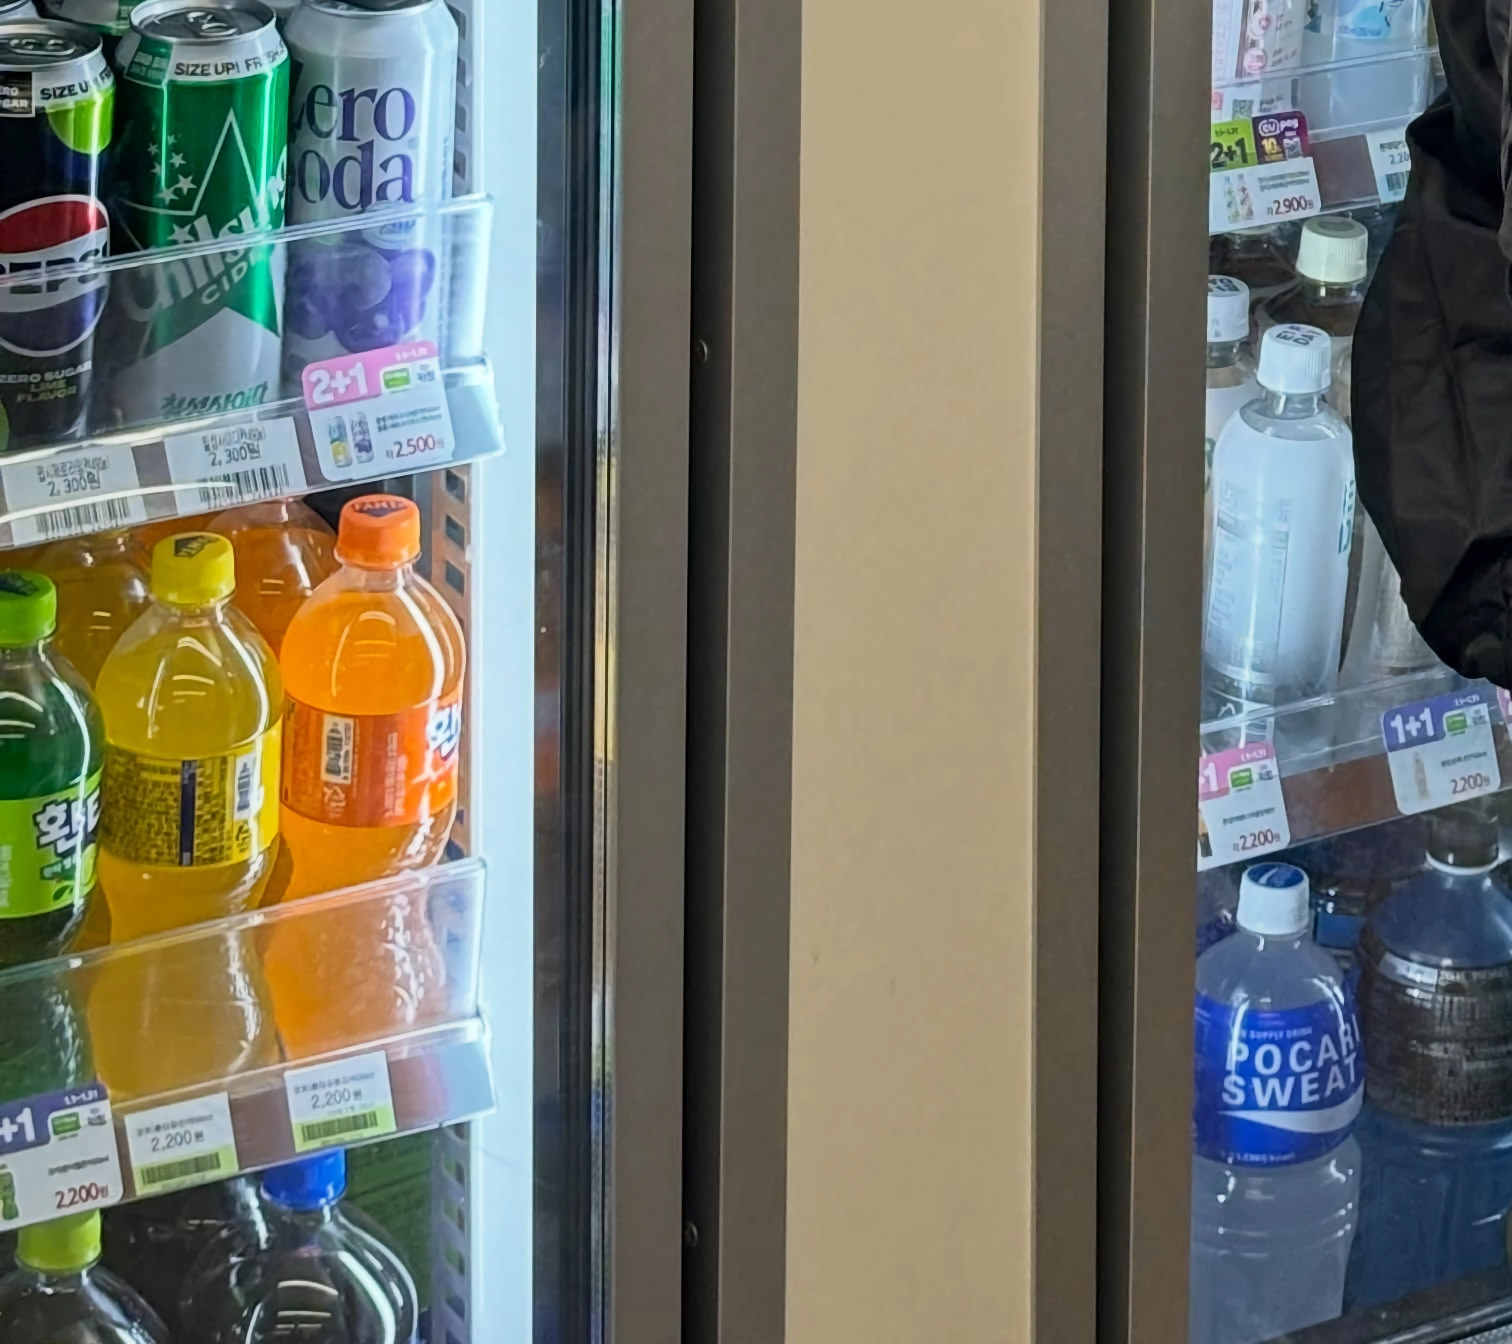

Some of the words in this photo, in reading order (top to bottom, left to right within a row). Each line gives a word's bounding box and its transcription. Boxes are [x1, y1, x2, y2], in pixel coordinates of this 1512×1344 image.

[174, 62, 212, 77] SIZE
[213, 60, 241, 76] UP!
[40, 83, 79, 101] SIZE
[300, 83, 416, 142] ero
[1211, 137, 1249, 169] 2+1
[299, 137, 416, 211] oda
[309, 360, 370, 403] 2+1
[1390, 707, 1435, 744] 1+1
[1225, 1014, 1361, 1076] POCARI
[311, 1090, 363, 1110] 2,200원
[1222, 1057, 1359, 1109] SWEAT
[0, 1107, 36, 1143] +1
[151, 1130, 204, 1152] 2,200원
